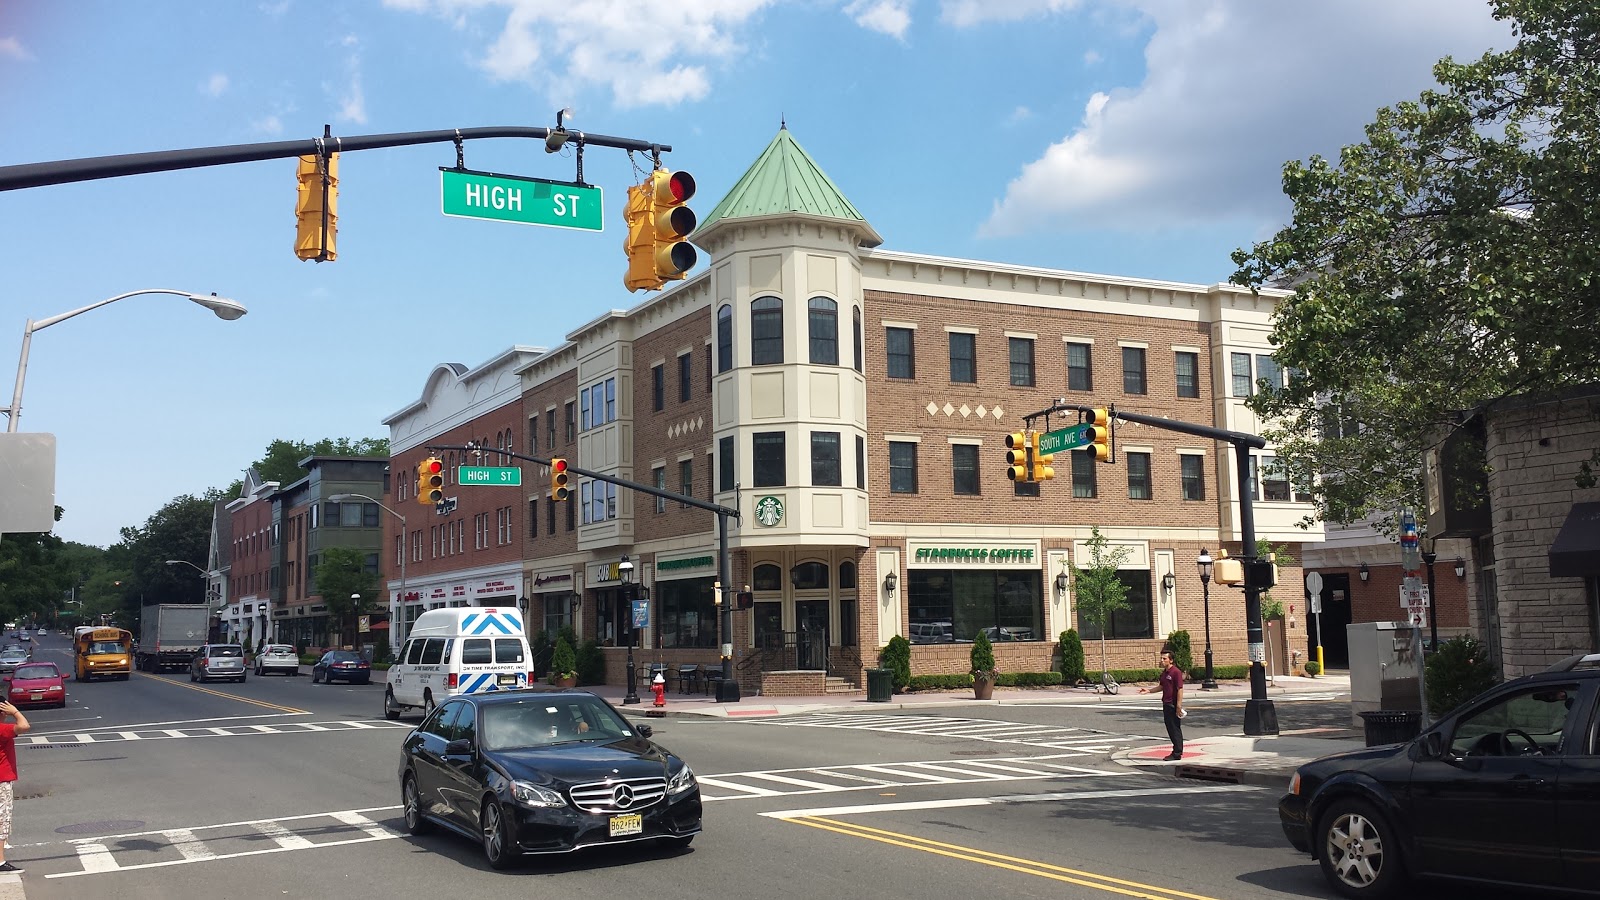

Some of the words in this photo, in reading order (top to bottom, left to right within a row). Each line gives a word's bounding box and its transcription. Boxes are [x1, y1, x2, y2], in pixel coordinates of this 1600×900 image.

[465, 183, 522, 211] HIGH
[553, 193, 580, 217] ST
[1040, 436, 1060, 451] SOUTH
[1064, 432, 1076, 445] AVE
[467, 471, 490, 481] HIGH
[501, 471, 512, 481] ST
[915, 548, 988, 558] STARBUCKS
[990, 549, 1034, 558] COFFEE
[597, 563, 619, 581] SUBWA
